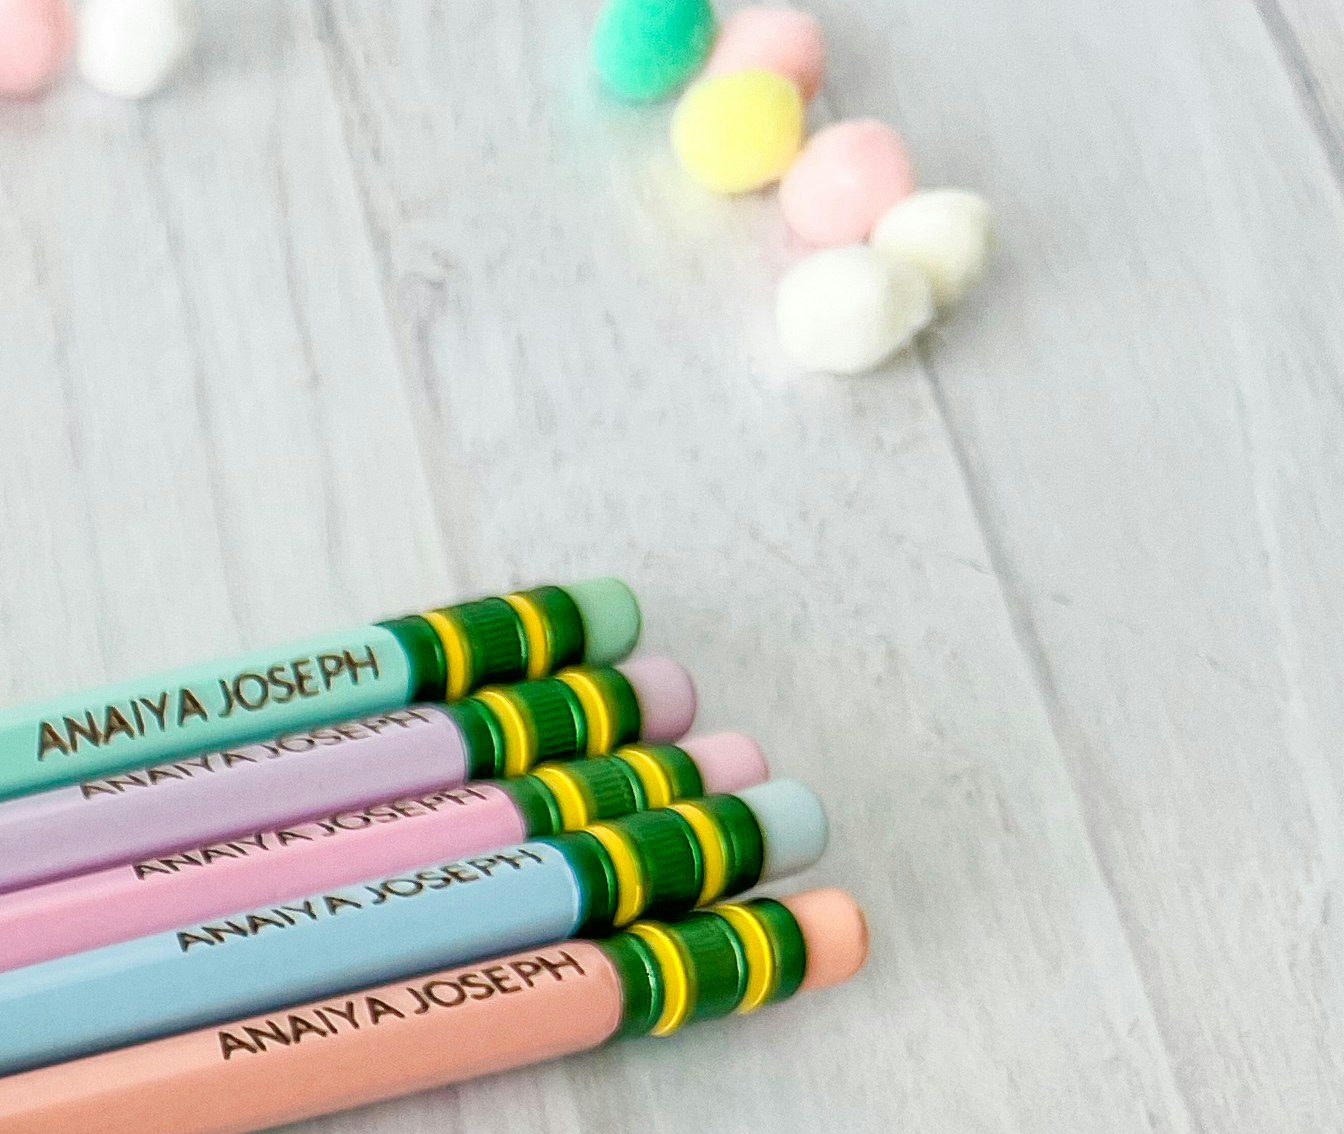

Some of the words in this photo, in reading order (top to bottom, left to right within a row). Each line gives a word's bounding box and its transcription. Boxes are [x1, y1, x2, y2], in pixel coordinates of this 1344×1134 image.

[38, 688, 208, 761] ANAIYA
[217, 645, 379, 717] JOSEPH
[81, 752, 258, 799] ANAIYA
[261, 708, 430, 759] JOSEPH
[133, 829, 313, 880] ANAIYA
[316, 787, 488, 837] JOSEPH
[176, 896, 362, 953] ANAIYA
[364, 848, 543, 904] JOSEPH
[218, 995, 405, 1060] ANAIYA
[407, 951, 586, 1015] JOSEPH
